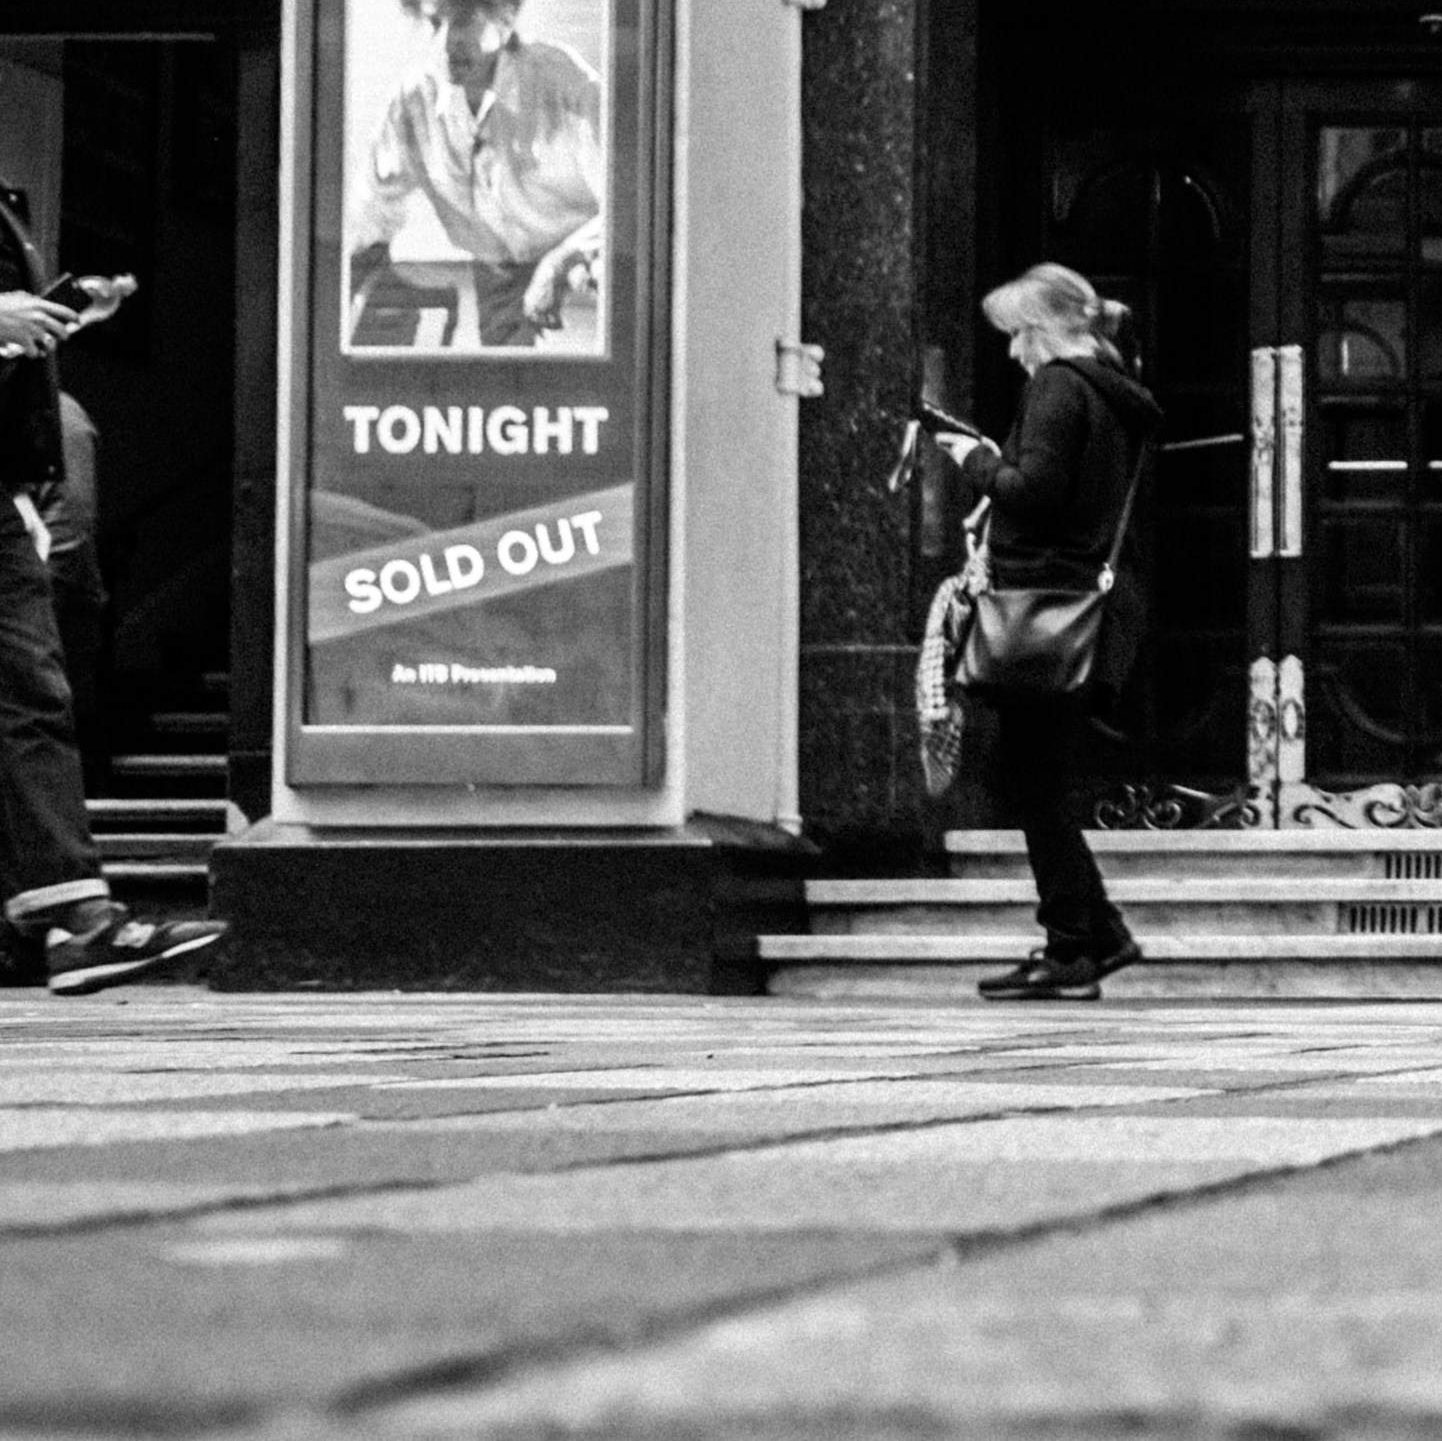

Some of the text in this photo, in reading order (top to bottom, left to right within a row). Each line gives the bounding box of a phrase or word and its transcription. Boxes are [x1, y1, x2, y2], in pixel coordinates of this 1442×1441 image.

[343, 405, 609, 455] TONIGHT
[345, 510, 603, 614] SOLD OUT
